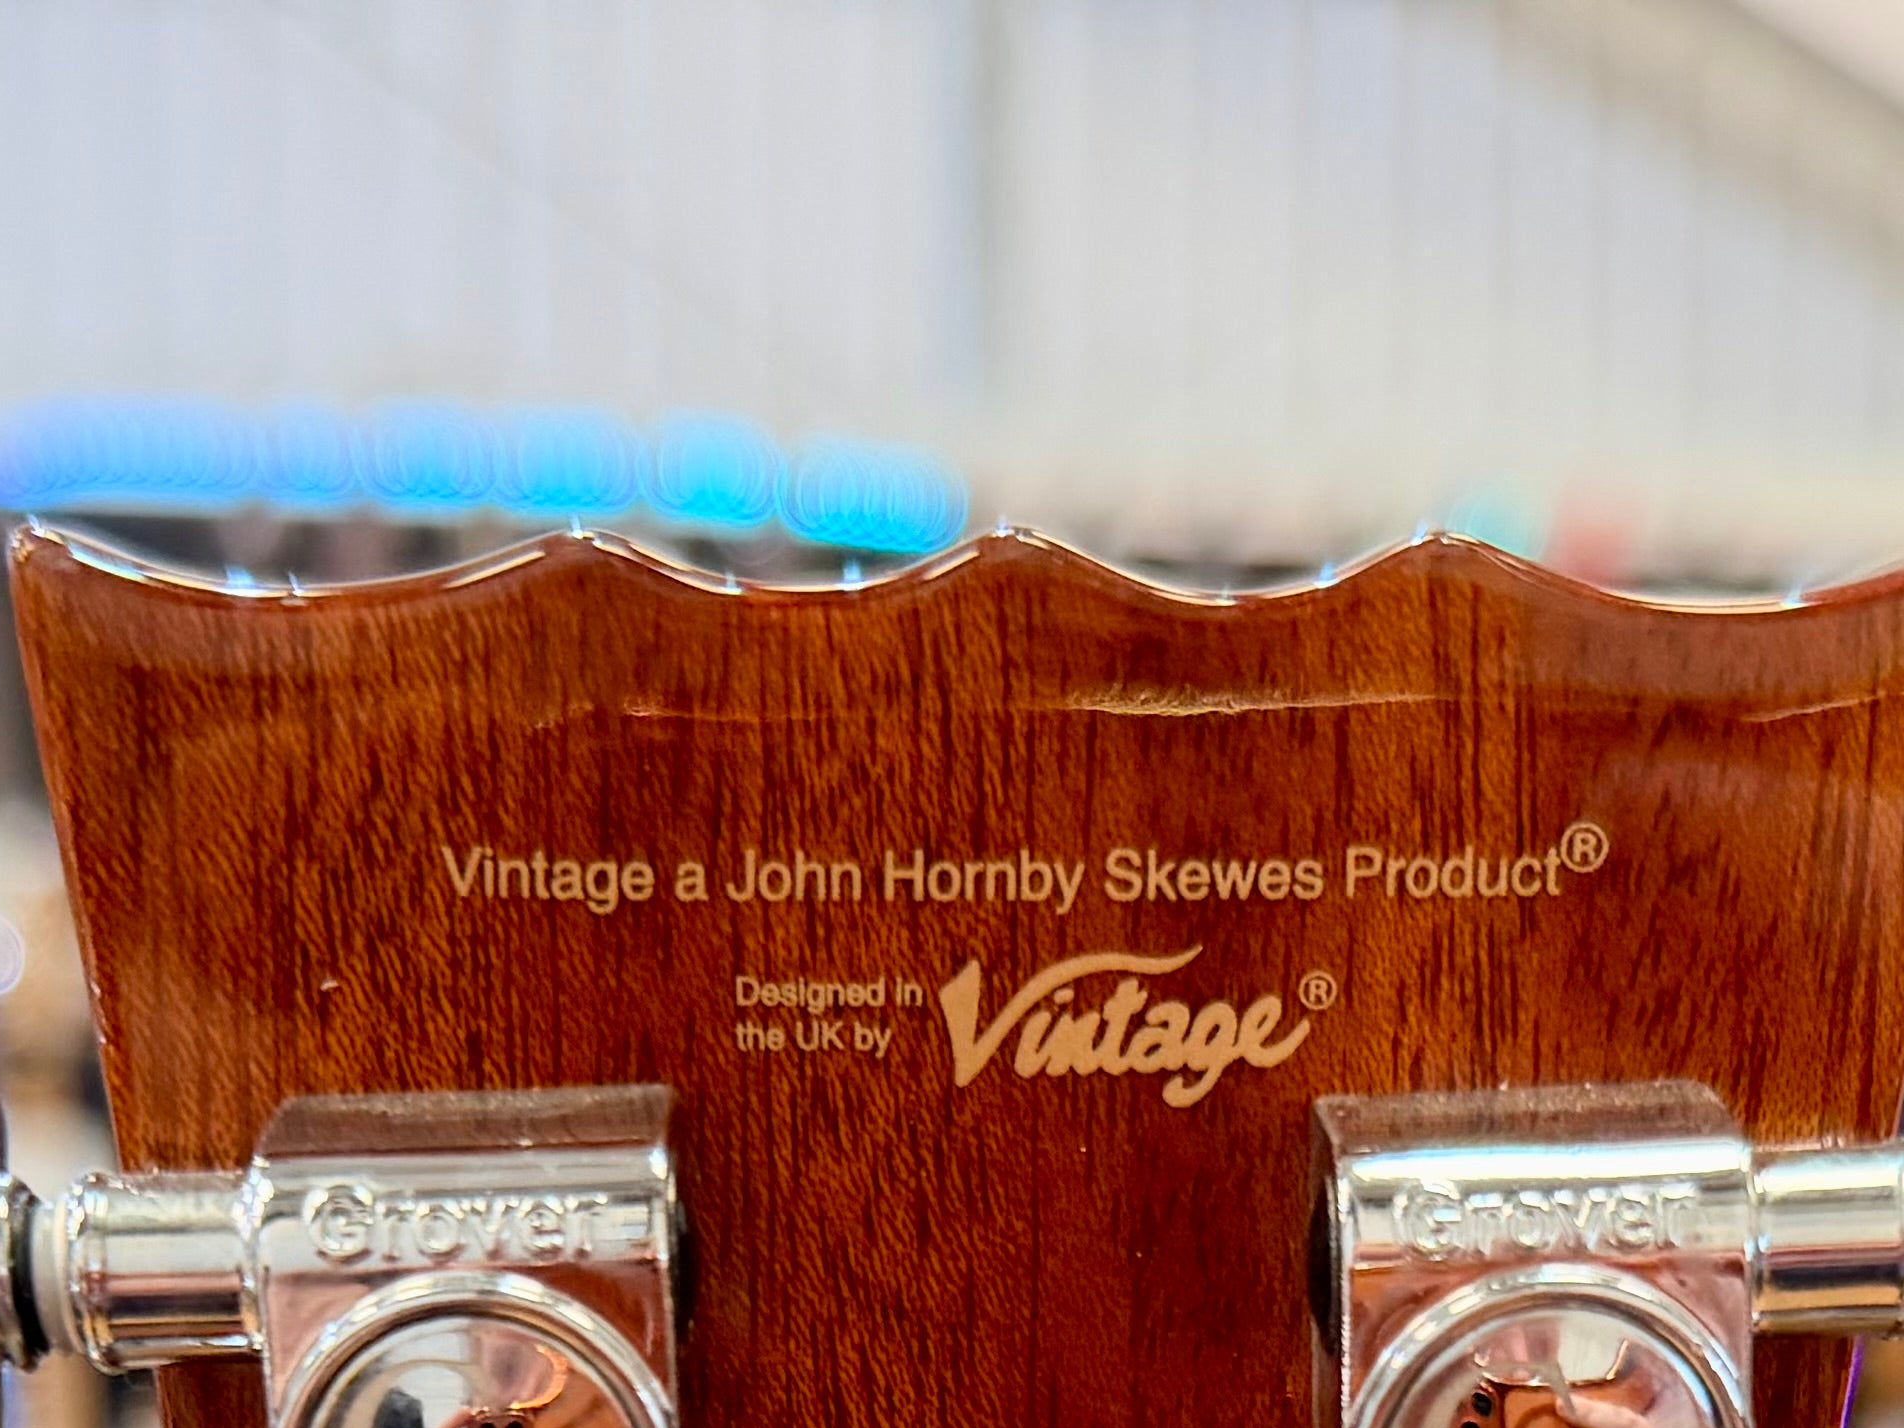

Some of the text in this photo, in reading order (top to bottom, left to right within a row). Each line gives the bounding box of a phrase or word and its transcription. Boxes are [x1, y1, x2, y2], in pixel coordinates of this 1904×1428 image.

[440, 845, 655, 915] Vintage
[673, 862, 708, 901] a
[726, 848, 863, 902] John
[884, 848, 1085, 915] Hornby
[1103, 848, 1325, 902] Skewes
[734, 975, 924, 1016] Designed in
[735, 1019, 893, 1059] the UK by
[304, 1182, 612, 1262] Grover
[1392, 1177, 1702, 1262] Grover
